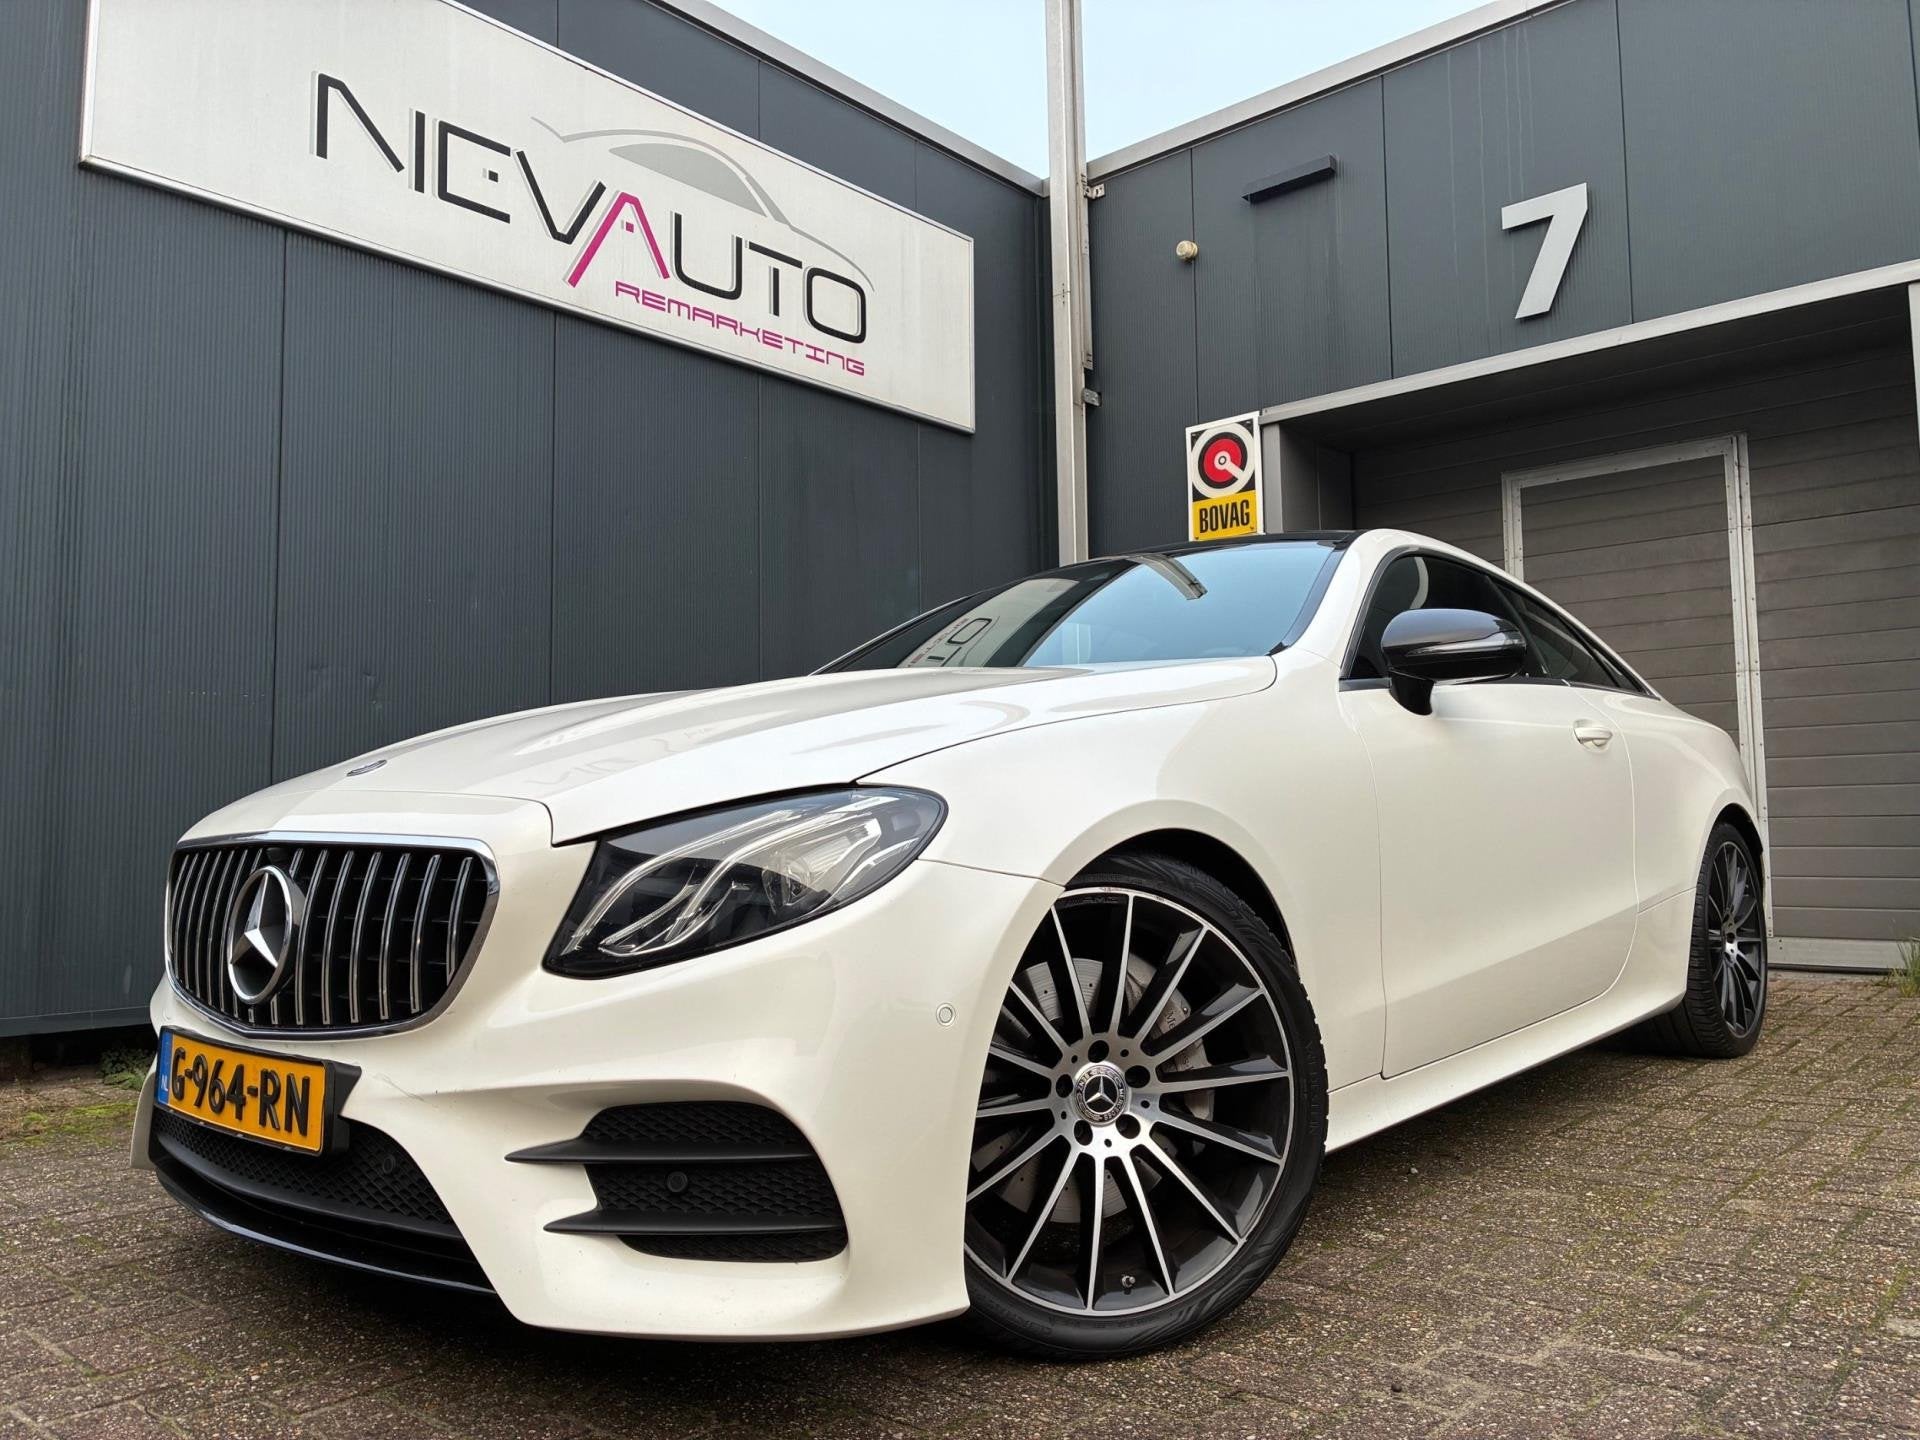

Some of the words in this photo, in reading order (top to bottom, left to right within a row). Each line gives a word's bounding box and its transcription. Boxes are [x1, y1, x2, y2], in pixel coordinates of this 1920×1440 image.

[1501, 182, 1588, 319] 7
[615, 280, 864, 376] REMARKETING
[1199, 499, 1250, 534] BOVAG
[171, 1046, 310, 1137] G-964-RN
